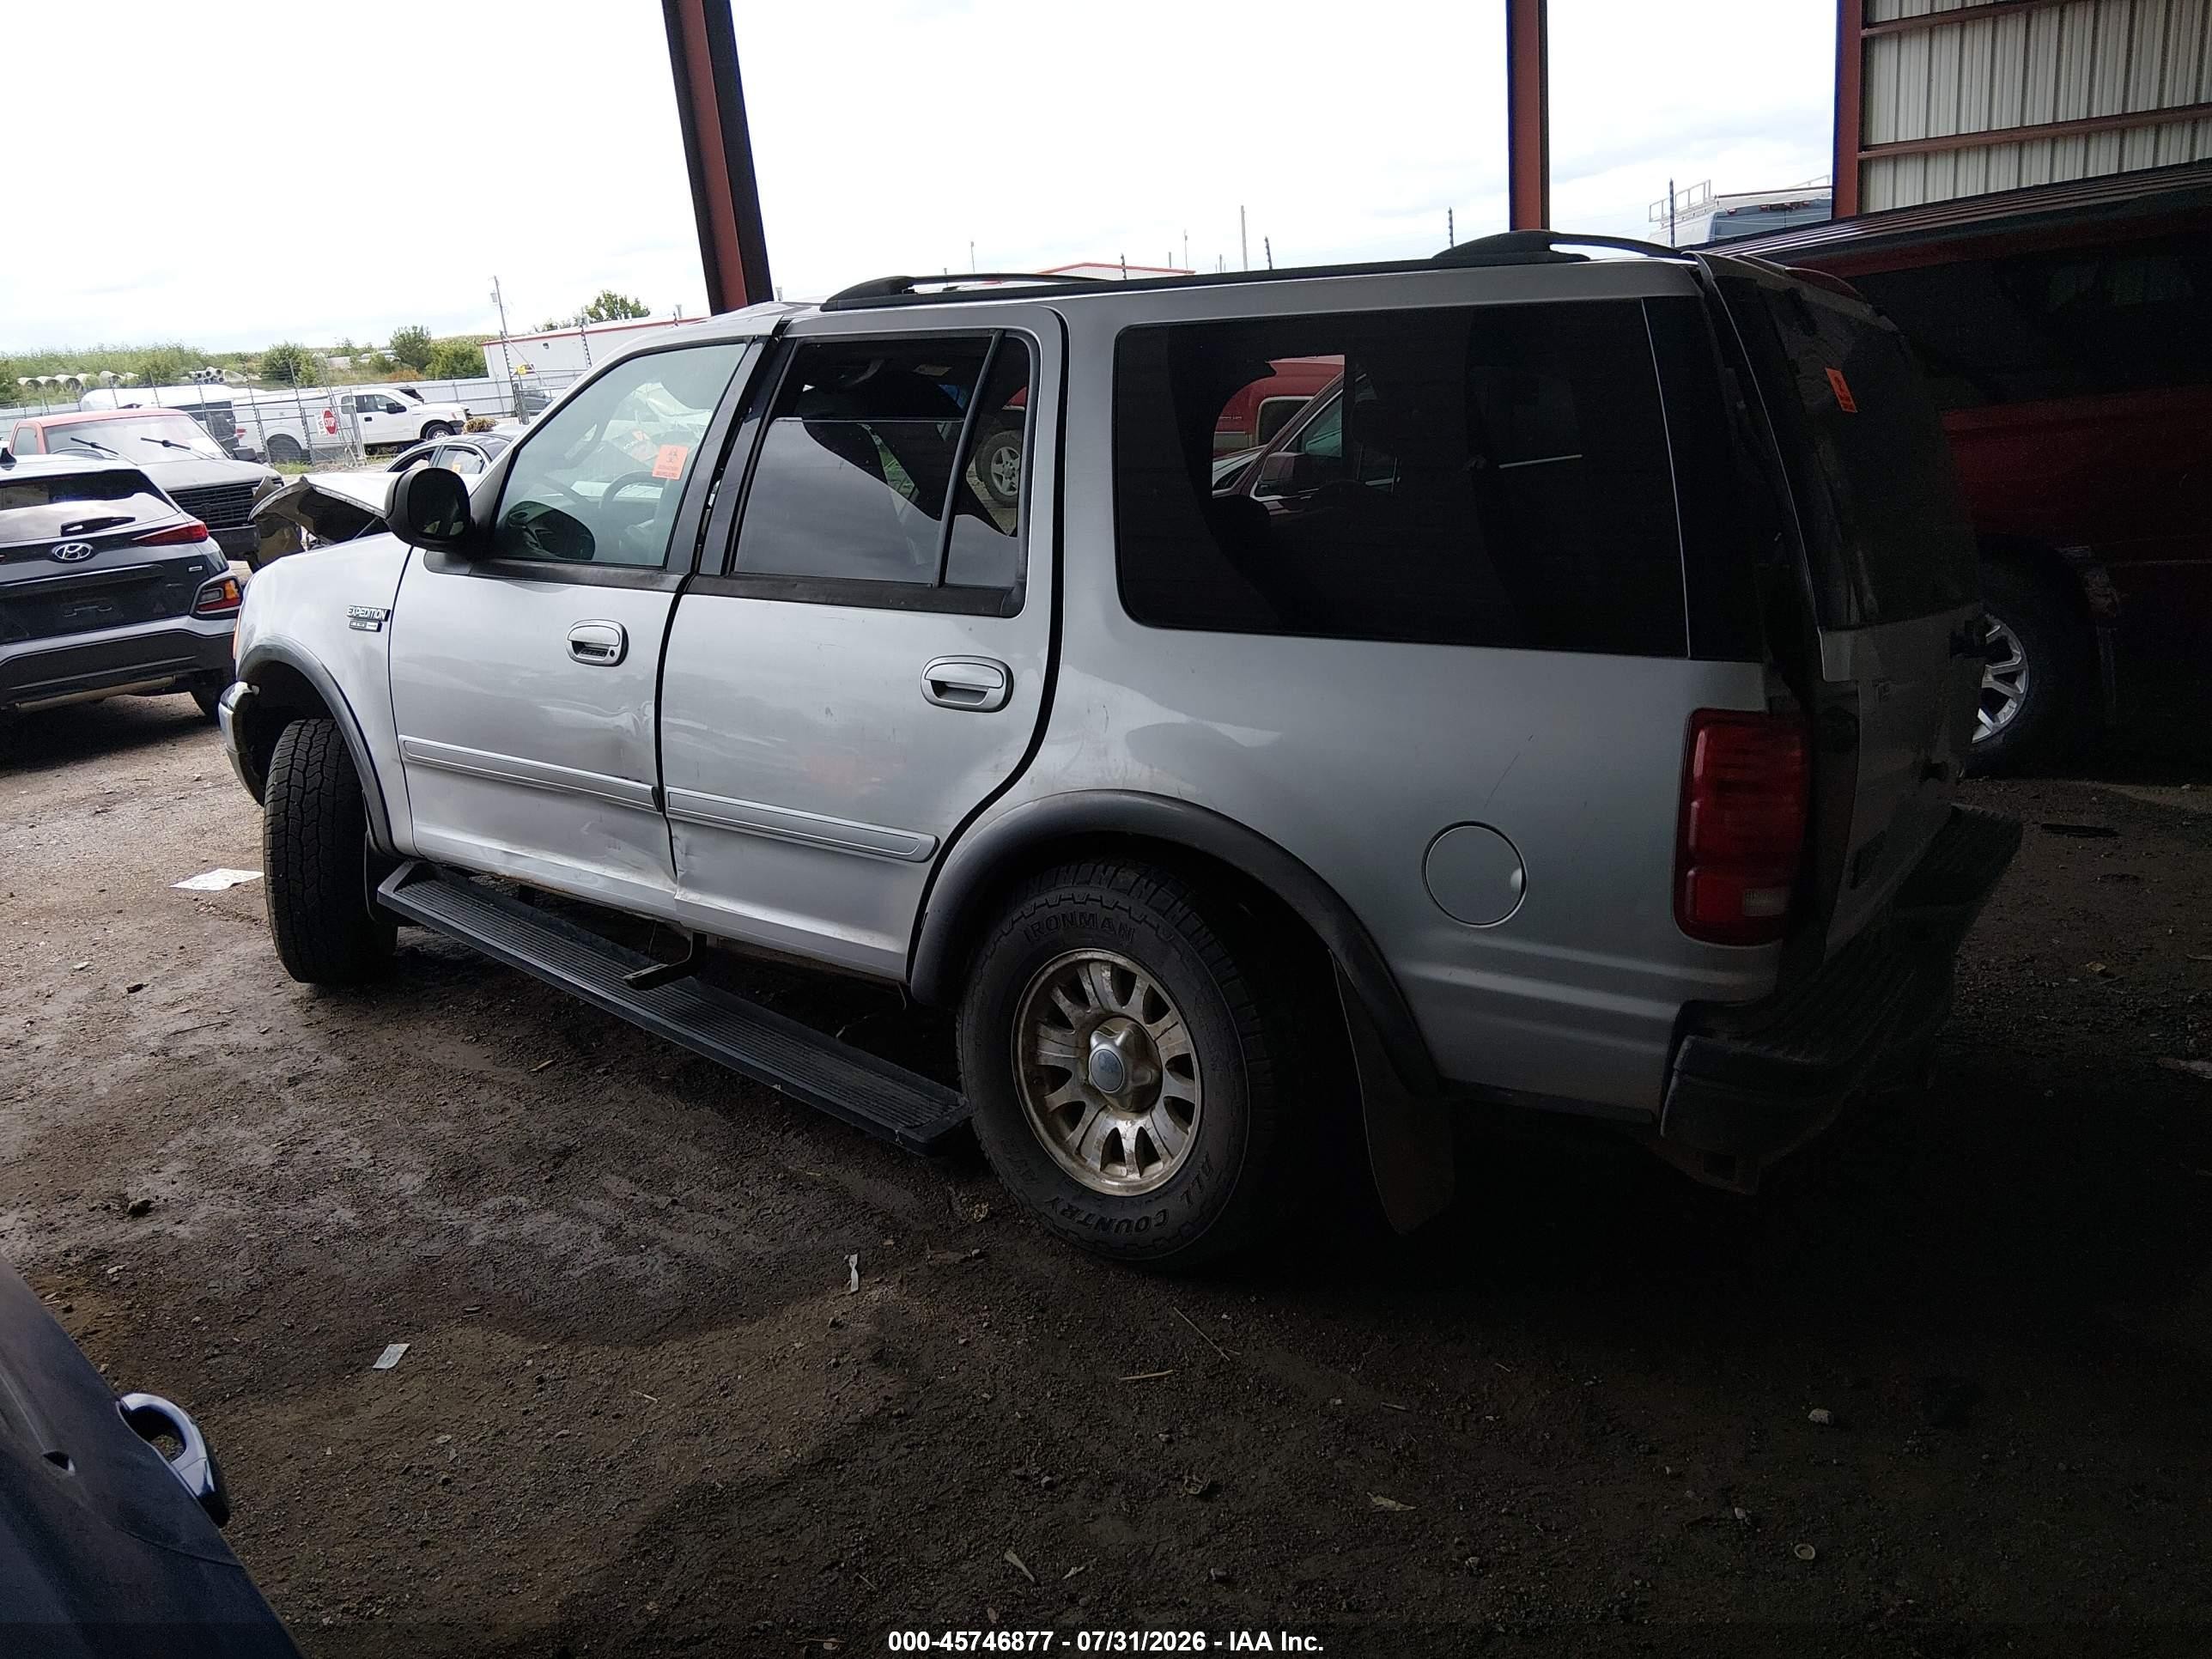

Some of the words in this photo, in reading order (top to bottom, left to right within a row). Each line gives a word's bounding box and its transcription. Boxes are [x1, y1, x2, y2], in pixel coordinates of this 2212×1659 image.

[324, 416, 336, 428] STOP
[347, 606, 388, 621] EXPEDITION
[1023, 912, 1135, 943] IRONMAN
[1044, 1196, 1168, 1236] COUNTRY
